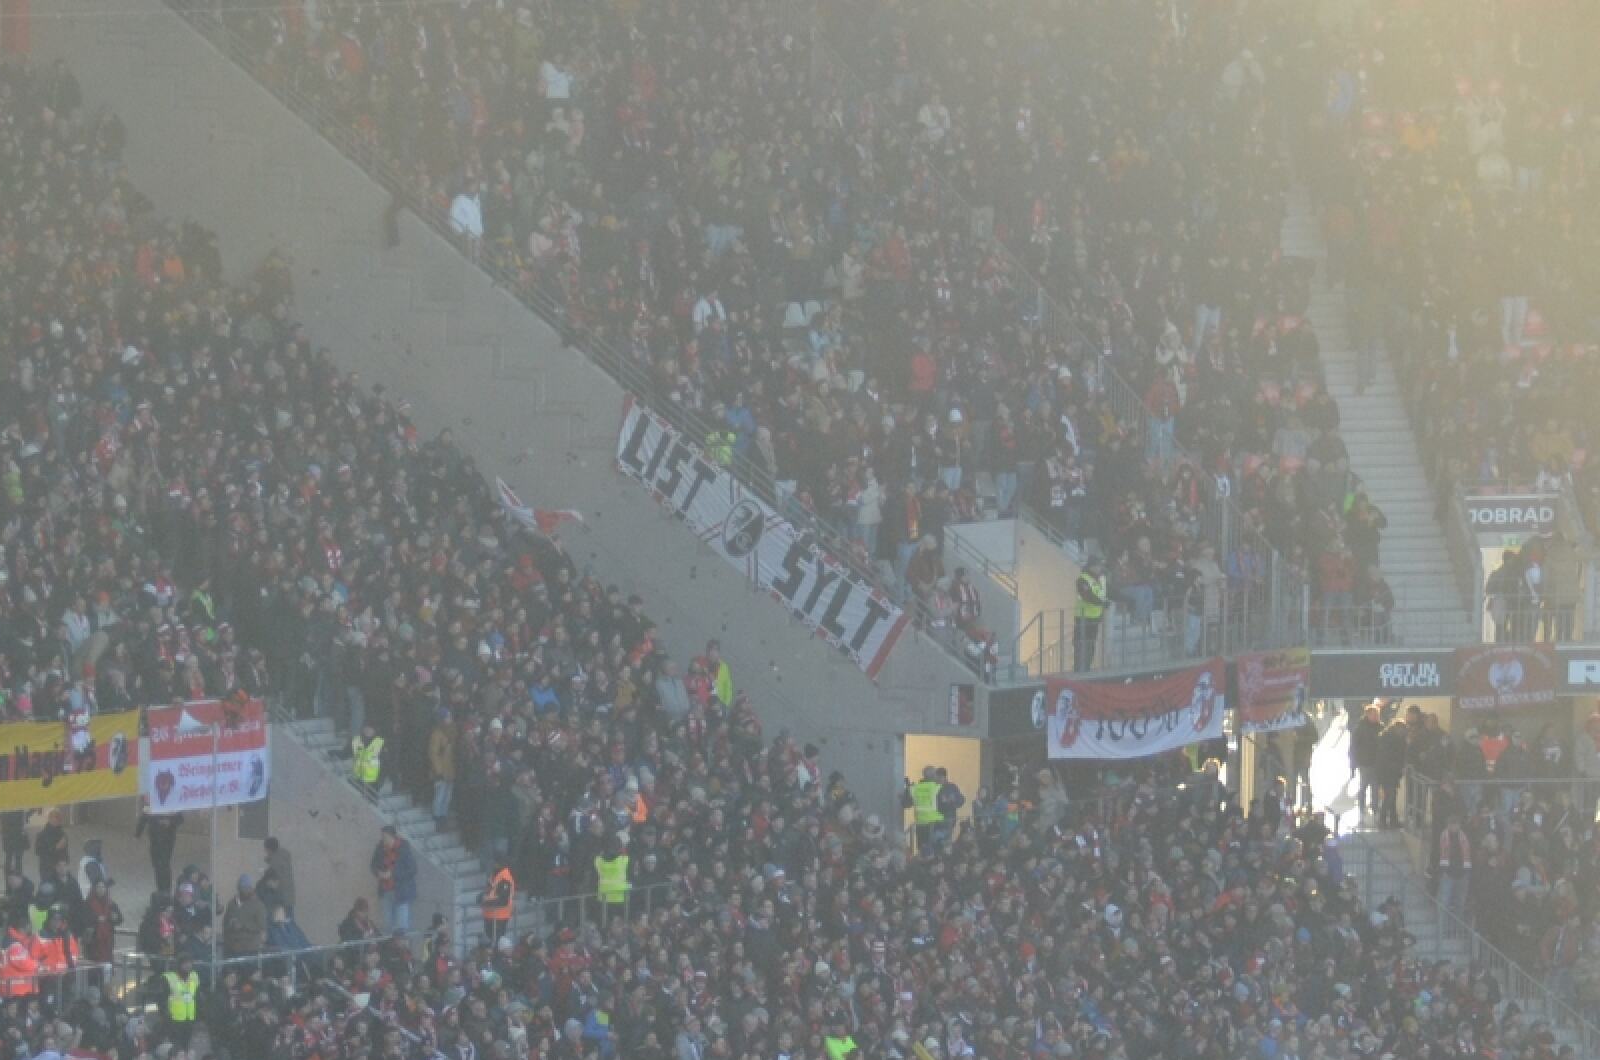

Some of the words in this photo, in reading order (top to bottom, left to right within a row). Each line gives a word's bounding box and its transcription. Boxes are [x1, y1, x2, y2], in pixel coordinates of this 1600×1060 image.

[1469, 505, 1554, 524] JOBRAD
[621, 413, 717, 512] LIST
[771, 543, 893, 655] SYLT
[1380, 663, 1411, 677] GET
[1418, 663, 1437, 677] IN
[1381, 674, 1440, 688] TOUCH
